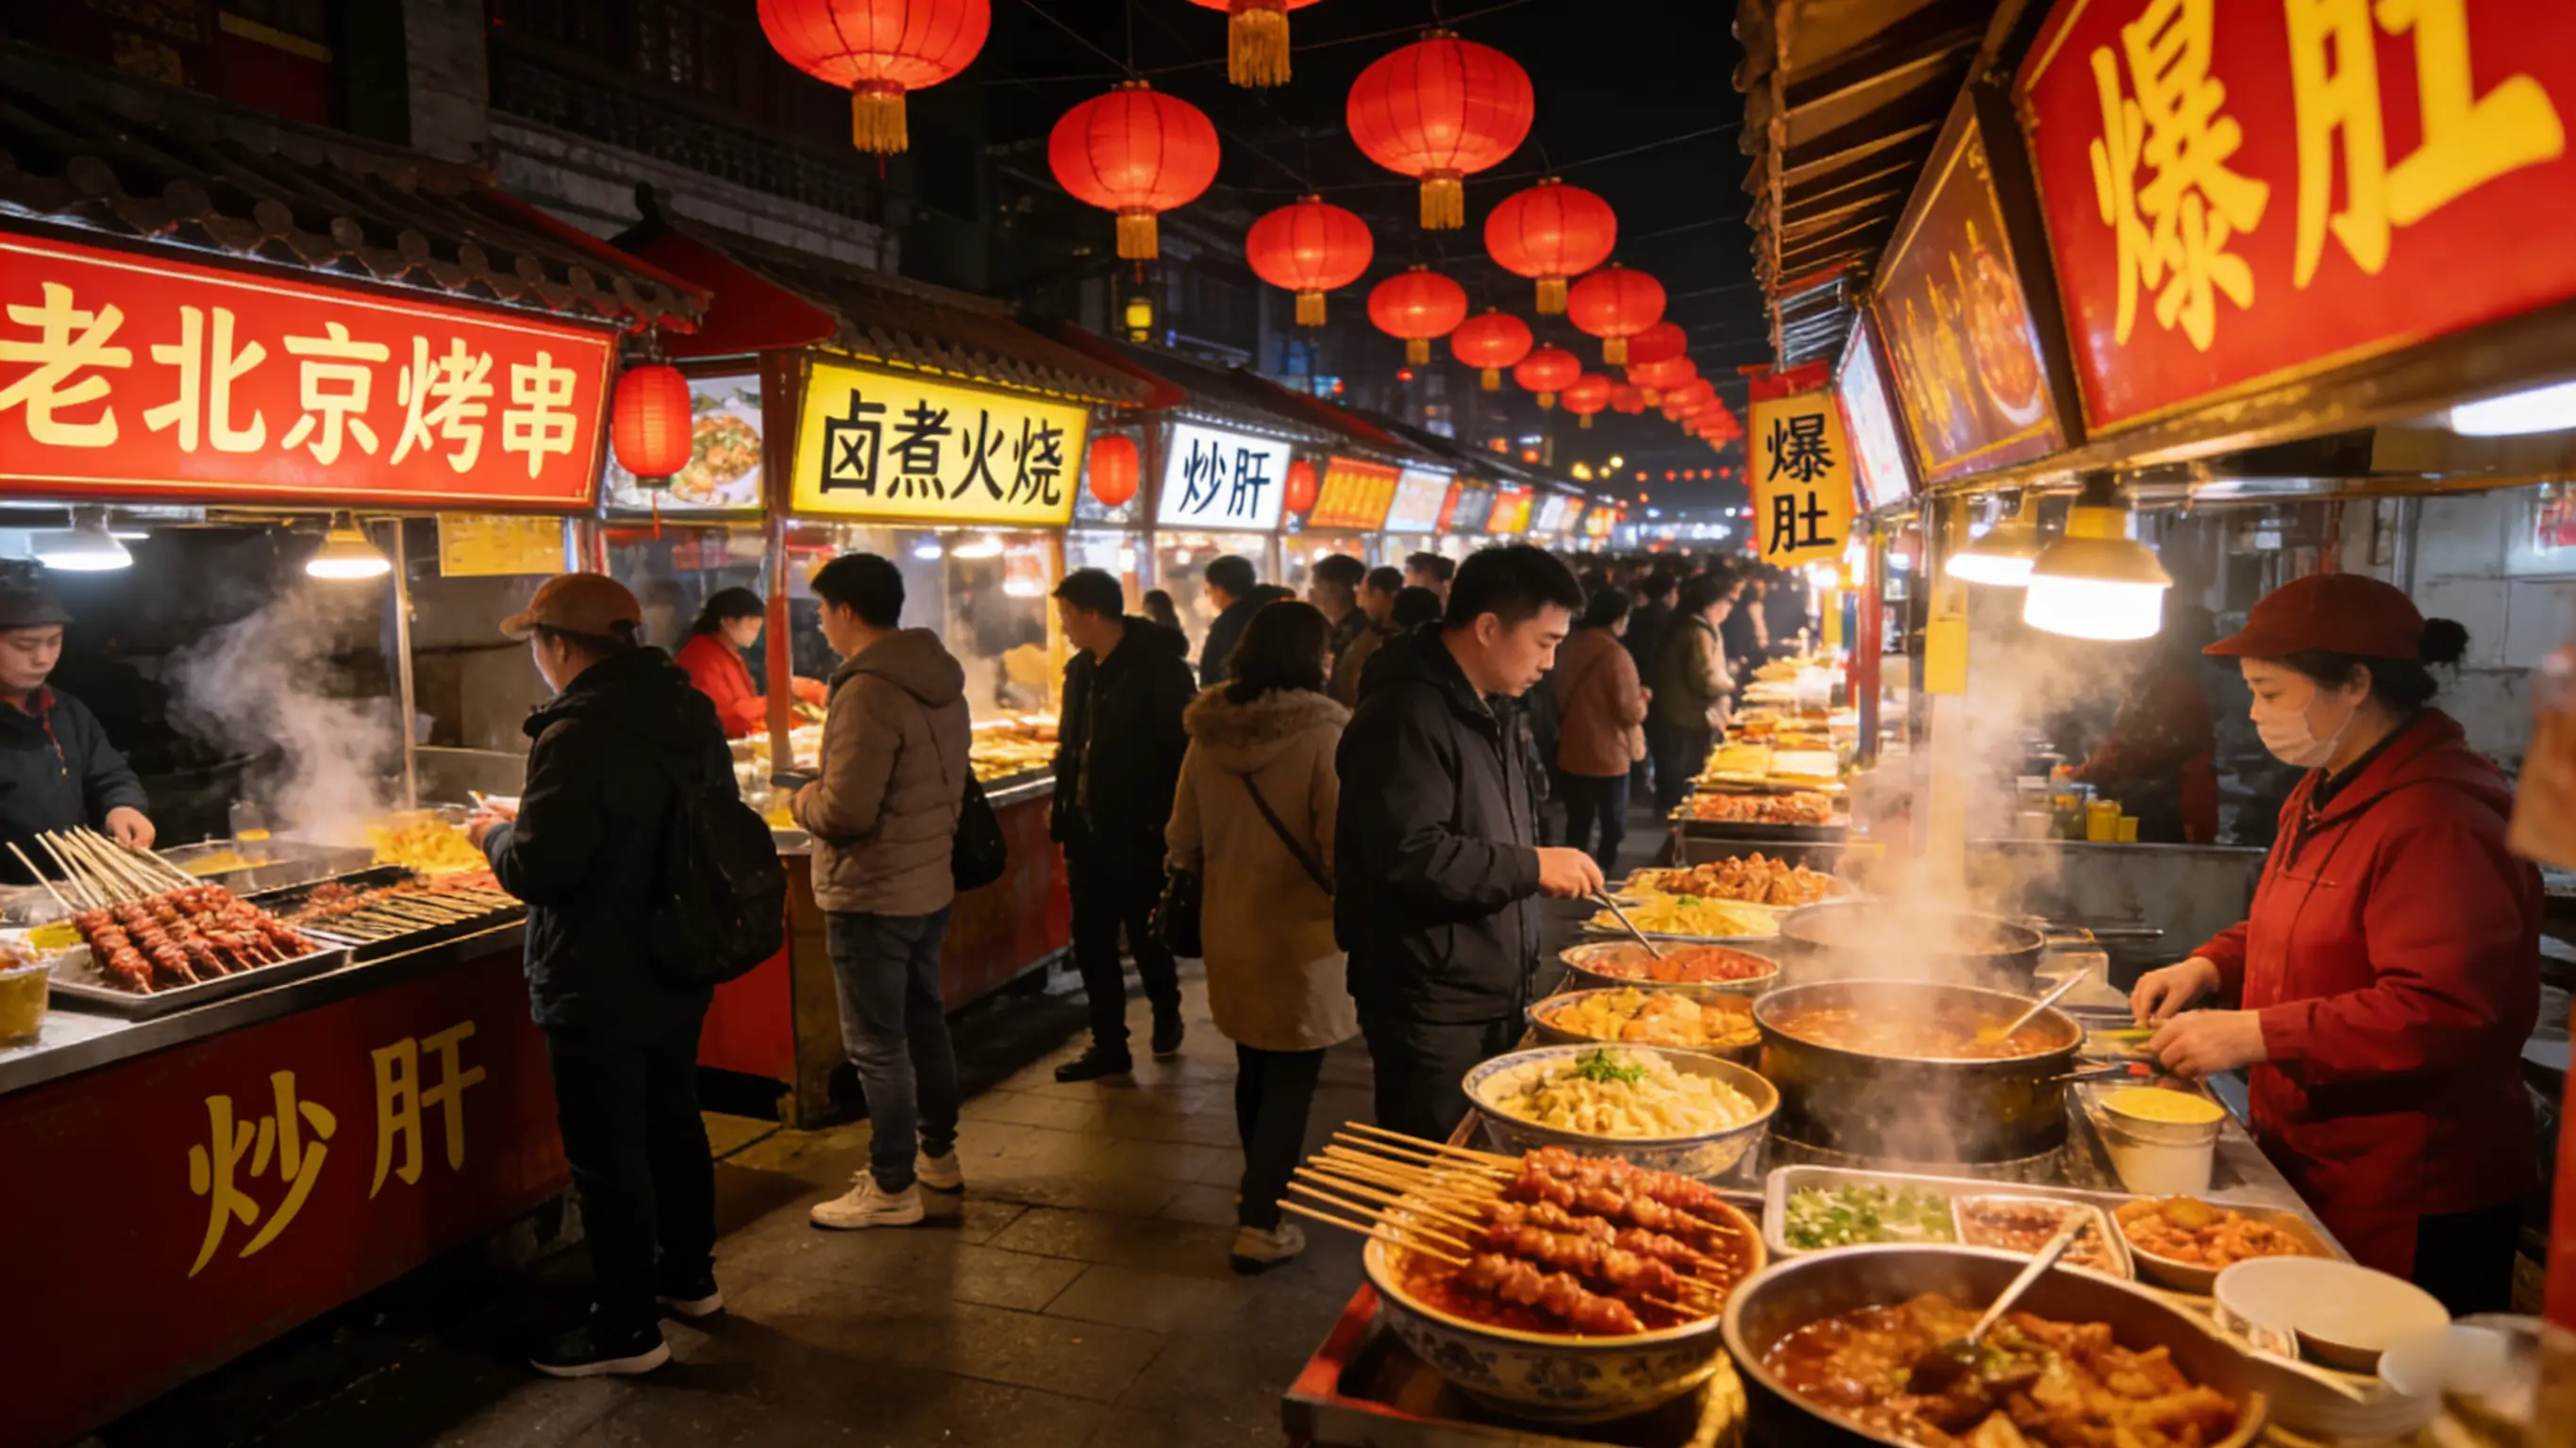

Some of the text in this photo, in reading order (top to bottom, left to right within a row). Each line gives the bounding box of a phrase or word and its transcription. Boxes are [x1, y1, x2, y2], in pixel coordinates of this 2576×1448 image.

[2088, 0, 2565, 352] 爆肚
[0, 282, 577, 479] 老北京烤串
[820, 389, 1063, 506] 卤煮火烧
[1178, 439, 1270, 519] 炒肝
[1766, 412, 1836, 556] 爆肚
[188, 1022, 486, 1278] 炒肝
